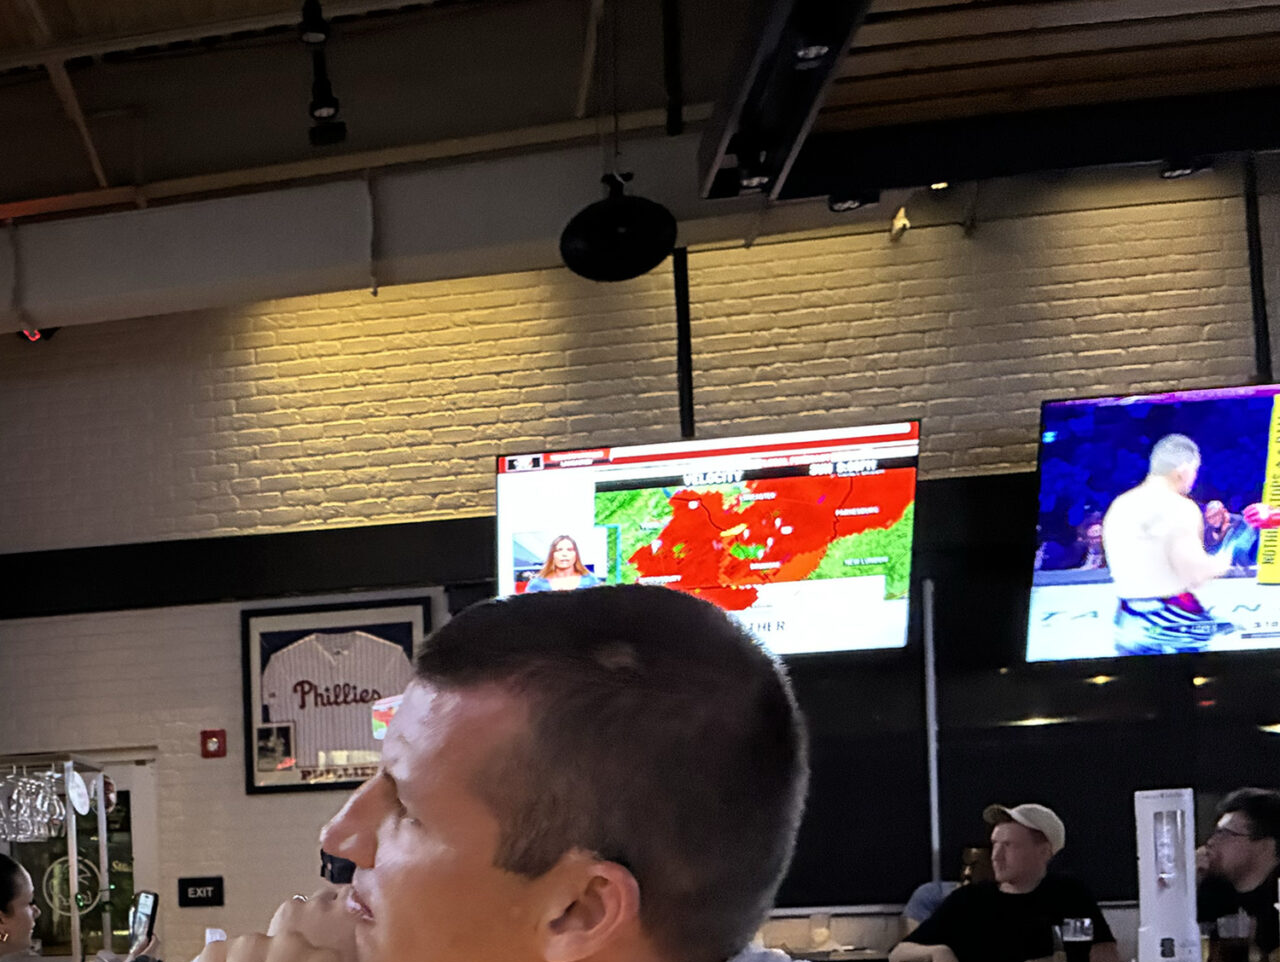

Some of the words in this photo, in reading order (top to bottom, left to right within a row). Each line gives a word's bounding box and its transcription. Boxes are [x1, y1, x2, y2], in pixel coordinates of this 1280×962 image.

[682, 469, 745, 488] VELOCITY
[292, 678, 383, 710] Phillies
[187, 886, 214, 898] EXIT
